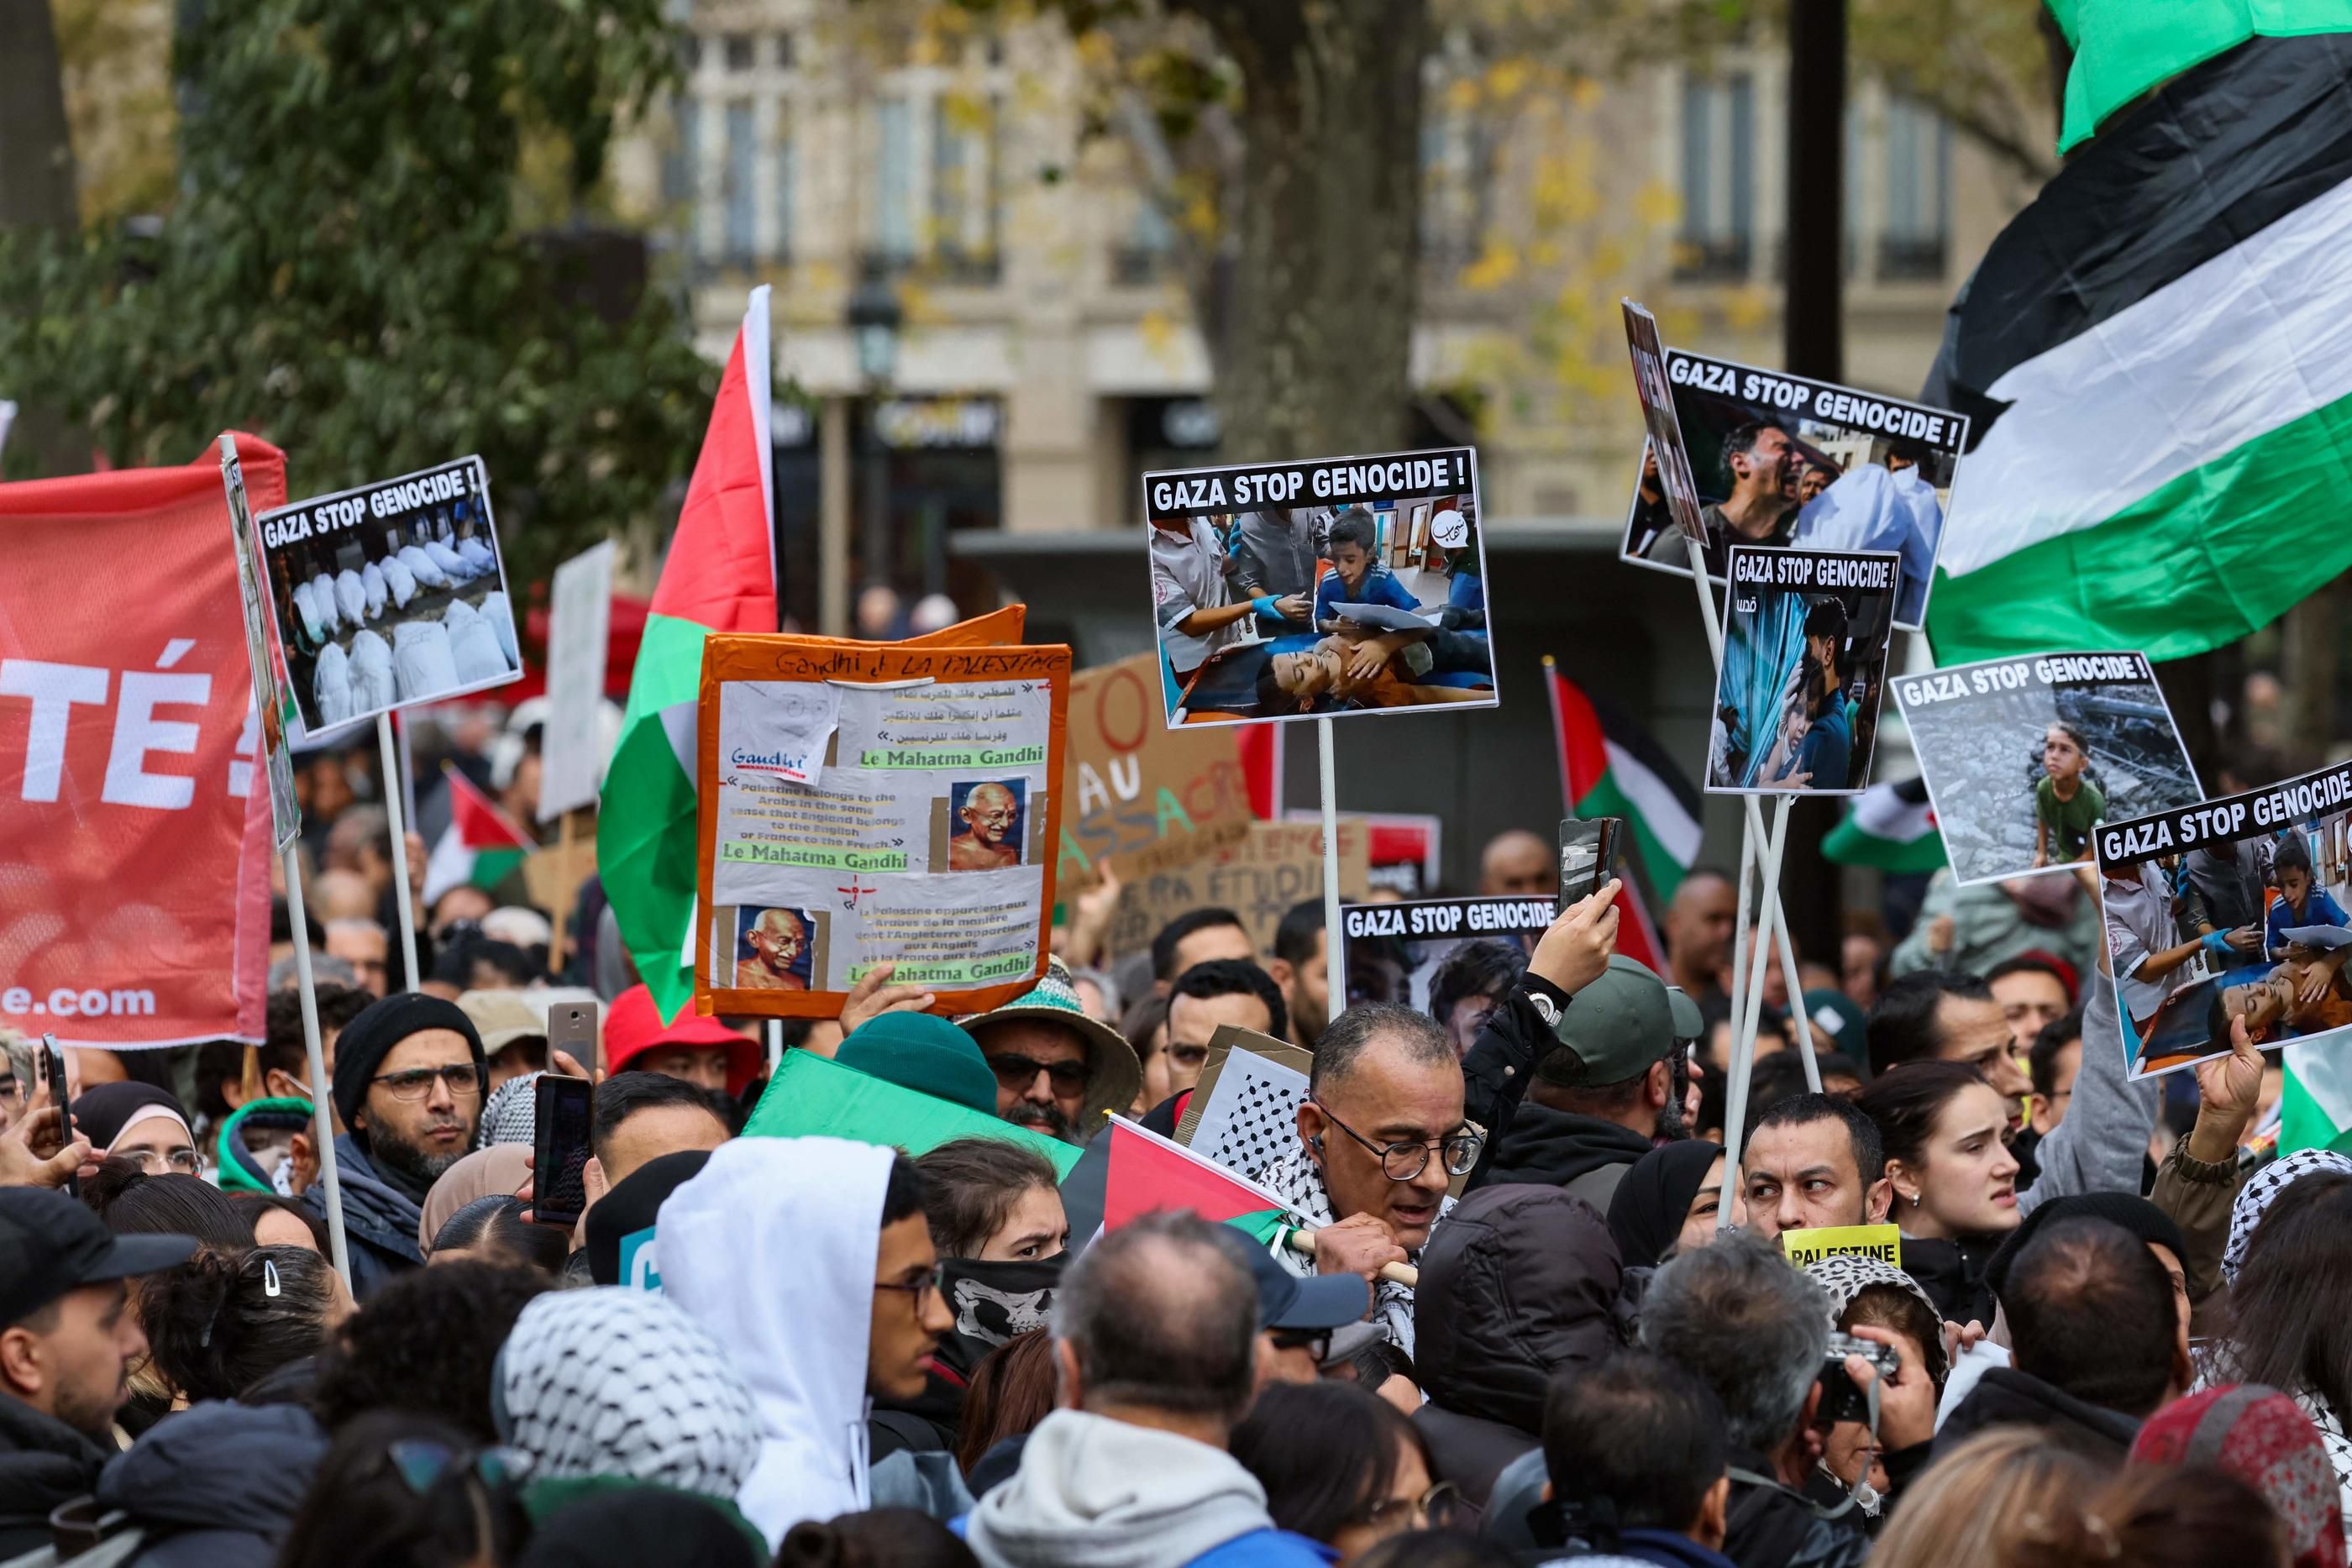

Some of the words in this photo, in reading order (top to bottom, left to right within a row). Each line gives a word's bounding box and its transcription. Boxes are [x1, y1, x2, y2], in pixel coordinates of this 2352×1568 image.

[1669, 357, 1736, 396] GAZA
[1741, 375, 1810, 411] STOP
[1814, 391, 1944, 444] GENOCIDE
[1154, 479, 1227, 511] GAZA
[1234, 472, 1303, 504] STOP
[1312, 459, 1449, 497] GENOCIDE
[1457, 457, 1465, 485] !
[265, 512, 312, 548] GAZA
[314, 497, 366, 534] STOP
[370, 469, 465, 518] GENOCIDE
[1735, 554, 1774, 583] GAZA
[1777, 556, 1813, 585] STOP
[1816, 559, 1889, 589] GENOCIDE
[776, 650, 860, 675] Gandhi
[1903, 674, 1971, 706] GAZA
[1971, 663, 2029, 694] STOP
[2034, 656, 2133, 684] GENOCIDE
[860, 750, 879, 765] Le
[887, 749, 972, 766] Mahatma
[979, 746, 1043, 765] Gandhi
[741, 784, 801, 796] Palestine
[804, 788, 854, 801] belongs
[858, 794, 872, 803] to
[1079, 753, 1141, 815] AU
[759, 796, 796, 807] Arabs
[801, 800, 811, 809] in
[769, 809, 797, 819] that
[801, 811, 853, 824] England
[2104, 820, 2173, 860] GAZA
[2180, 803, 2245, 842] STOP
[2254, 770, 2352, 826] GENOCIDE
[758, 832, 801, 842] France
[789, 822, 810, 832] the
[814, 825, 859, 837] English
[723, 843, 744, 858] Le
[752, 845, 836, 866] Mahatma
[844, 853, 908, 870] Gandhi
[874, 906, 932, 915] Palestine
[935, 905, 1005, 916] appartient
[1006, 900, 1027, 910] aux
[1347, 909, 1406, 937] GAZA
[1411, 905, 1462, 935] STOP
[1467, 902, 1555, 931] GENOCIDE
[942, 918, 953, 926] la
[965, 921, 1031, 937] appartient
[896, 953, 939, 962] France
[904, 942, 927, 951] aux
[932, 941, 978, 951] Anglais
[970, 955, 1031, 978] Gandhi
[2, 987, 156, 1016] e.com
